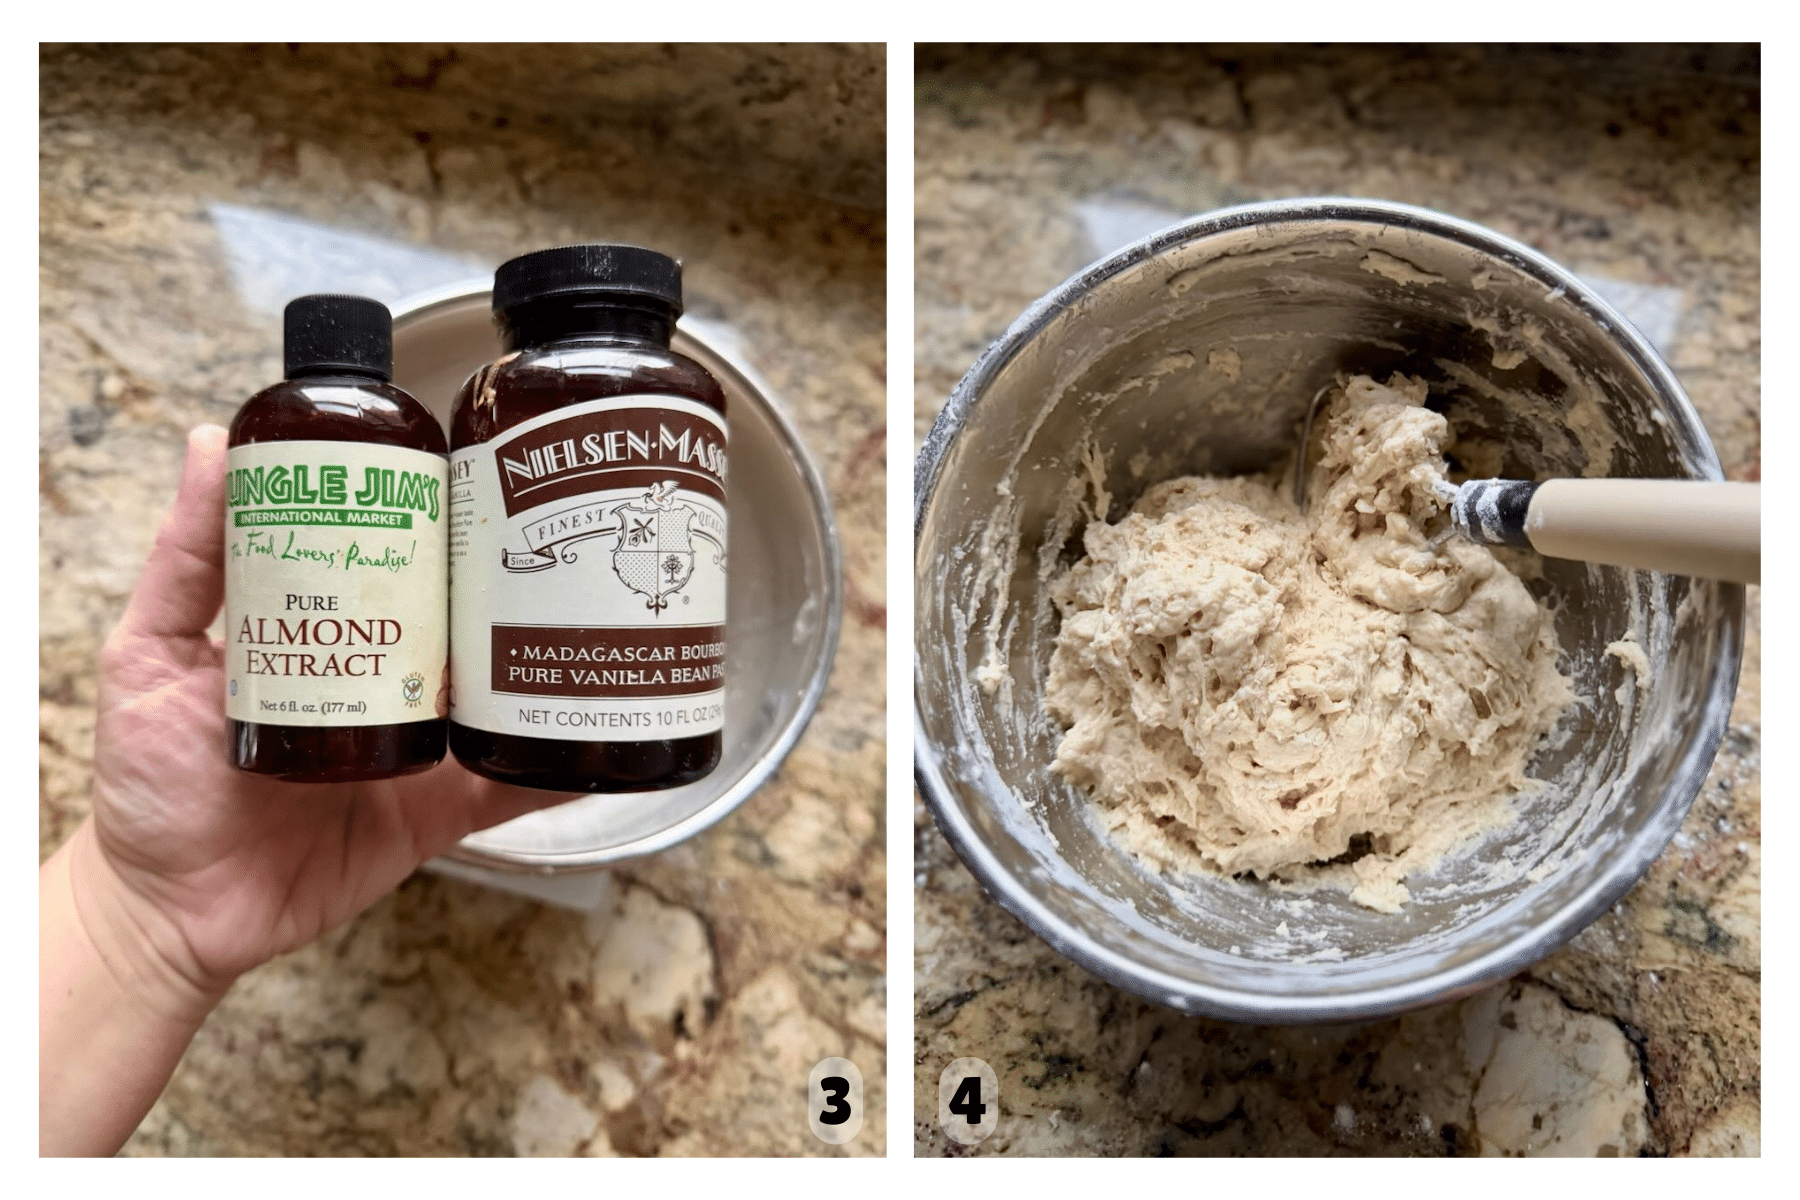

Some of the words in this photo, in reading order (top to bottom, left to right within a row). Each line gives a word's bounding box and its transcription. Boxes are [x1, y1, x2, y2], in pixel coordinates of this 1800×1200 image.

[226, 465, 349, 507] UNGLE
[355, 467, 440, 522] JIM'S
[241, 511, 341, 524] INTERNATIONAL
[347, 512, 403, 526] MARKET
[538, 508, 606, 540] FINEST
[247, 529, 277, 560] Food
[510, 557, 535, 566] Since
[285, 594, 339, 611] PURE
[237, 615, 402, 646] ALMOND
[246, 650, 387, 676] EXTRACT
[522, 645, 675, 663] MADAGASCAR
[681, 642, 725, 660] BOURBO
[401, 671, 425, 684] GLUTEN
[509, 667, 563, 685] PURE
[569, 669, 666, 686] VANILLA
[670, 665, 710, 684] BEAN
[260, 700, 277, 711] Net
[280, 701, 287, 712] 6
[288, 701, 299, 712] fl.
[302, 704, 318, 712] oz.
[321, 701, 345, 715] (177
[347, 701, 367, 715] ml)
[519, 708, 551, 724] NET
[556, 711, 651, 727] CONTENTS
[657, 711, 673, 725] 10
[677, 709, 690, 724] FL
[693, 706, 707, 722] OZ
